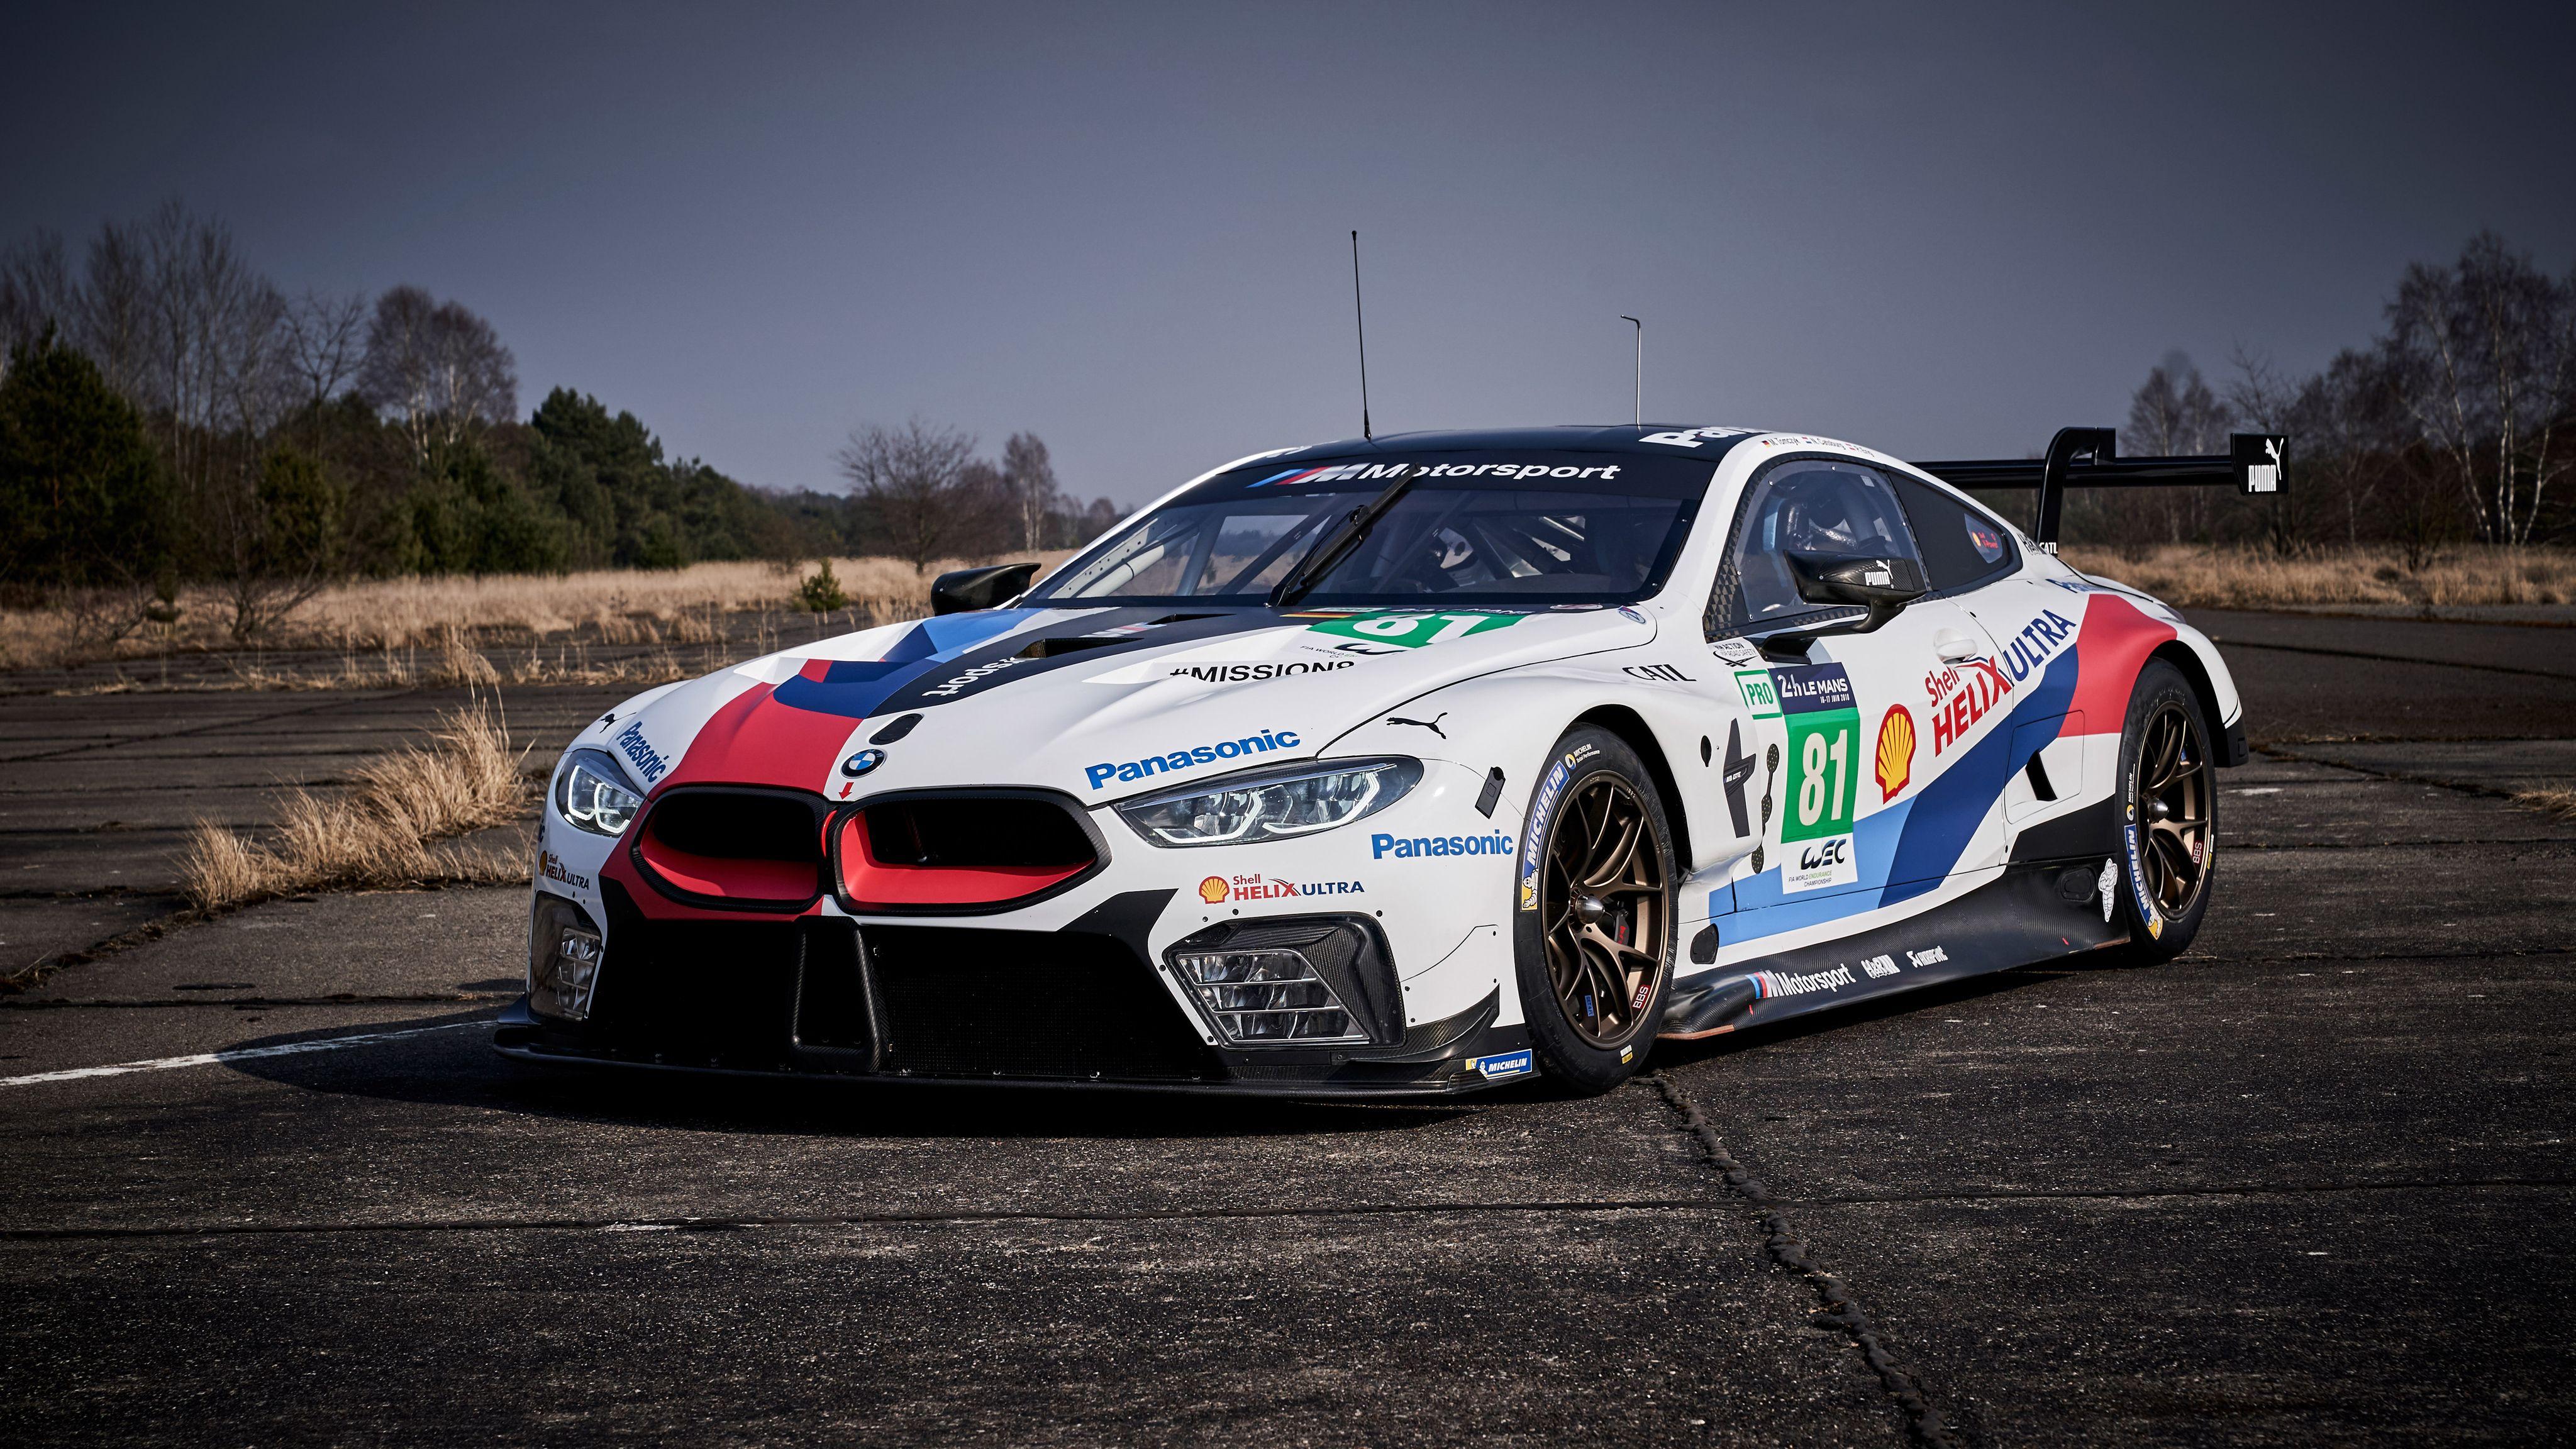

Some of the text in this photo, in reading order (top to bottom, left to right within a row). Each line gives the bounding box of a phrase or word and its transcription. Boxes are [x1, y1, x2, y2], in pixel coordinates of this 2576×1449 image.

[1357, 462, 1621, 481] Motorsport
[2248, 464, 2277, 492] PUMA
[1864, 571, 1890, 586] PUMA
[2002, 608, 2077, 683] ULTRA
[1621, 666, 1697, 682] CATL
[1802, 681, 1817, 696] LE
[1817, 678, 1848, 694] MANS
[1924, 663, 1961, 708] Shell
[1745, 681, 1774, 706] PRO
[1931, 655, 2014, 758] HELIX
[616, 721, 669, 783] Panasonic
[1085, 728, 1301, 790] Panasonic
[1797, 728, 1848, 827] 81
[1528, 765, 1564, 866] MICHELIN
[1371, 830, 1514, 860] Panasonic
[1801, 838, 1847, 870] WEC
[2192, 841, 2202, 864] BBS
[548, 853, 558, 864] Shell
[2128, 829, 2149, 910] MICHELIN
[545, 863, 589, 890] HELIX ULTRA
[1233, 874, 1261, 886] Shell
[1804, 877, 1832, 887] CHAMPIONSHIP
[1809, 870, 1833, 879] ENDURANCE
[1233, 880, 1365, 901] HELIX ULTRA
[1774, 963, 1857, 996] Motorsport
[1633, 985, 1649, 1009] BBS
[1488, 1058, 1528, 1072] MICHELIN
